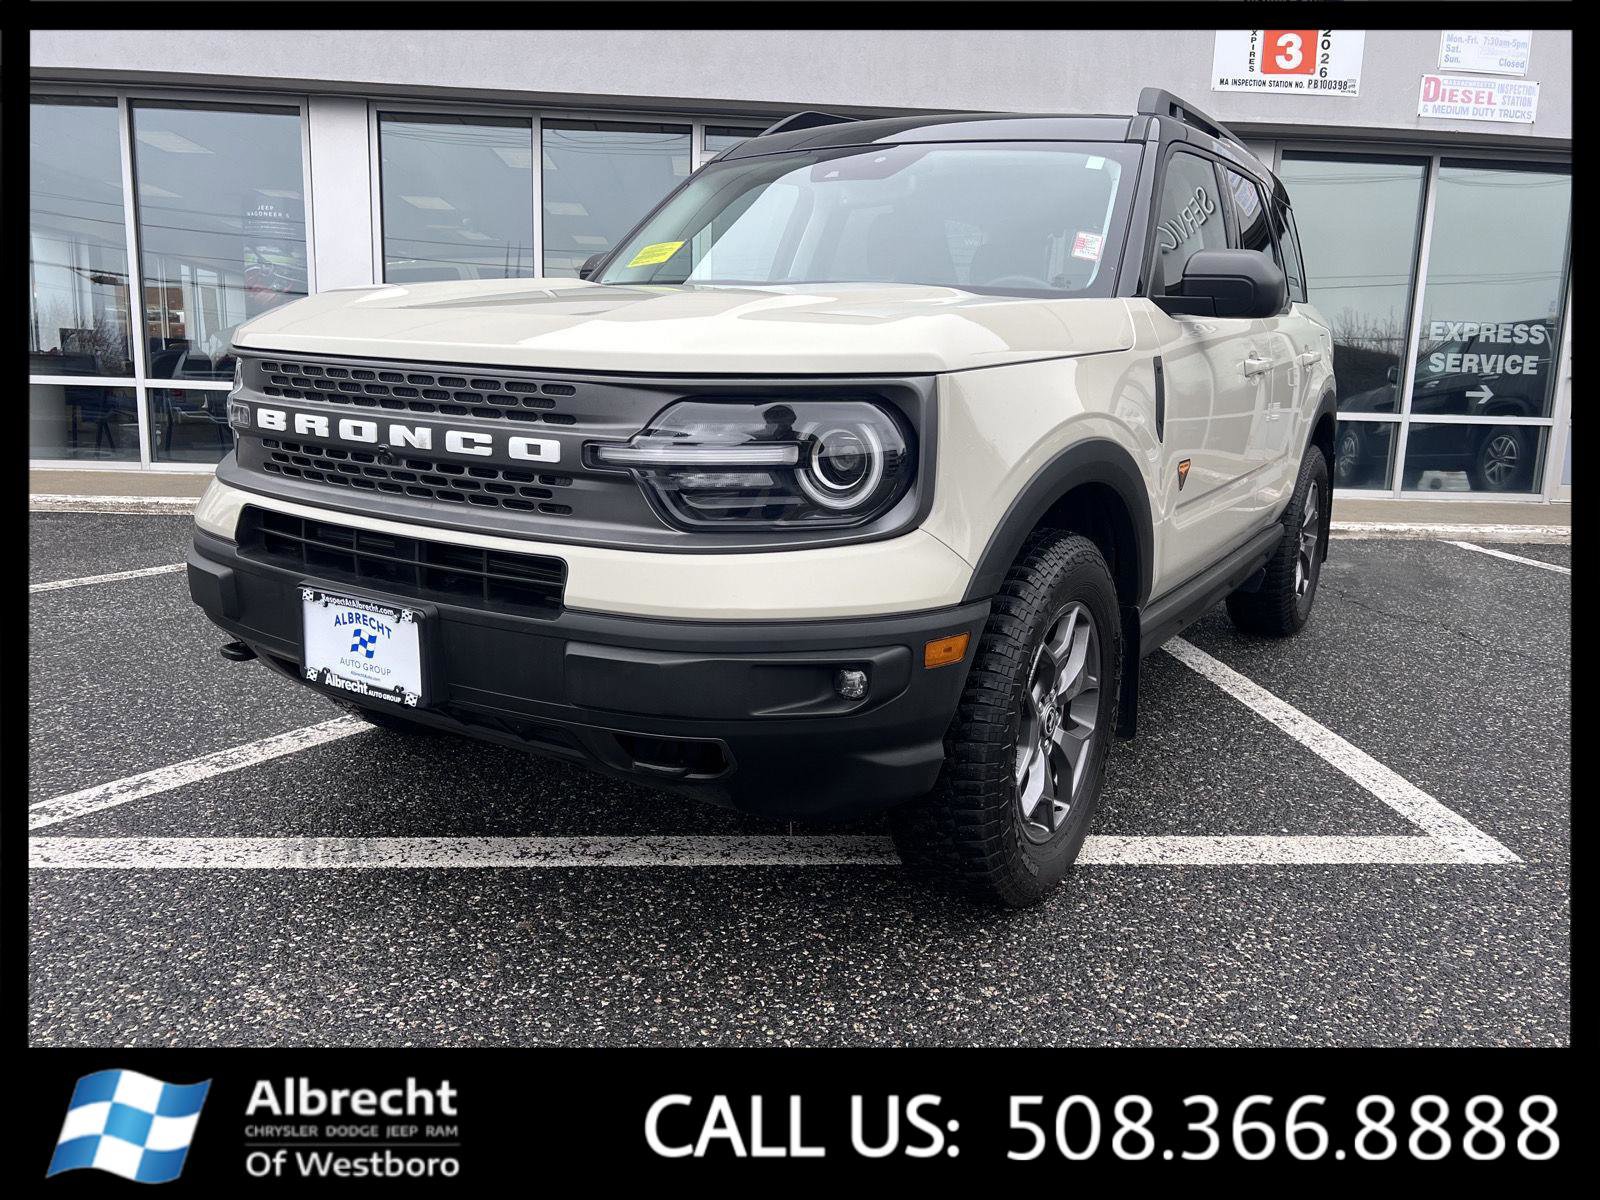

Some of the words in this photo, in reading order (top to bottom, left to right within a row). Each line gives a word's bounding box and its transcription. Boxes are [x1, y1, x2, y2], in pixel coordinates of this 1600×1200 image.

[1249, 30, 1257, 72] XPIRES
[1275, 33, 1303, 70] 3
[1319, 30, 1332, 78] 2026
[1445, 44, 1461, 53] Sat.
[1444, 54, 1461, 63] Sun.
[1499, 58, 1525, 69] Closed
[1219, 78, 1229, 86] MA
[1231, 79, 1266, 87] INSPECTION
[1268, 80, 1293, 88] STATION
[1295, 81, 1304, 89] NO.
[1422, 76, 1497, 106] DIESEL
[1498, 83, 1536, 96] INSPECTION
[1432, 105, 1469, 116] MEDIUM
[1472, 107, 1496, 118] DUTY
[1499, 108, 1533, 120] TRUCKS
[1501, 95, 1532, 107] STATION
[1428, 321, 1546, 345] EXPRESS
[1428, 352, 1539, 375] SERVICE
[256, 408, 561, 463] BRONCO
[334, 612, 392, 639] ALBRECHT
[340, 657, 361, 669] AUTO
[363, 663, 391, 676] GROUP
[325, 673, 369, 696] Albrecht
[368, 690, 382, 699] AUTO
[382, 692, 401, 703] GROUP
